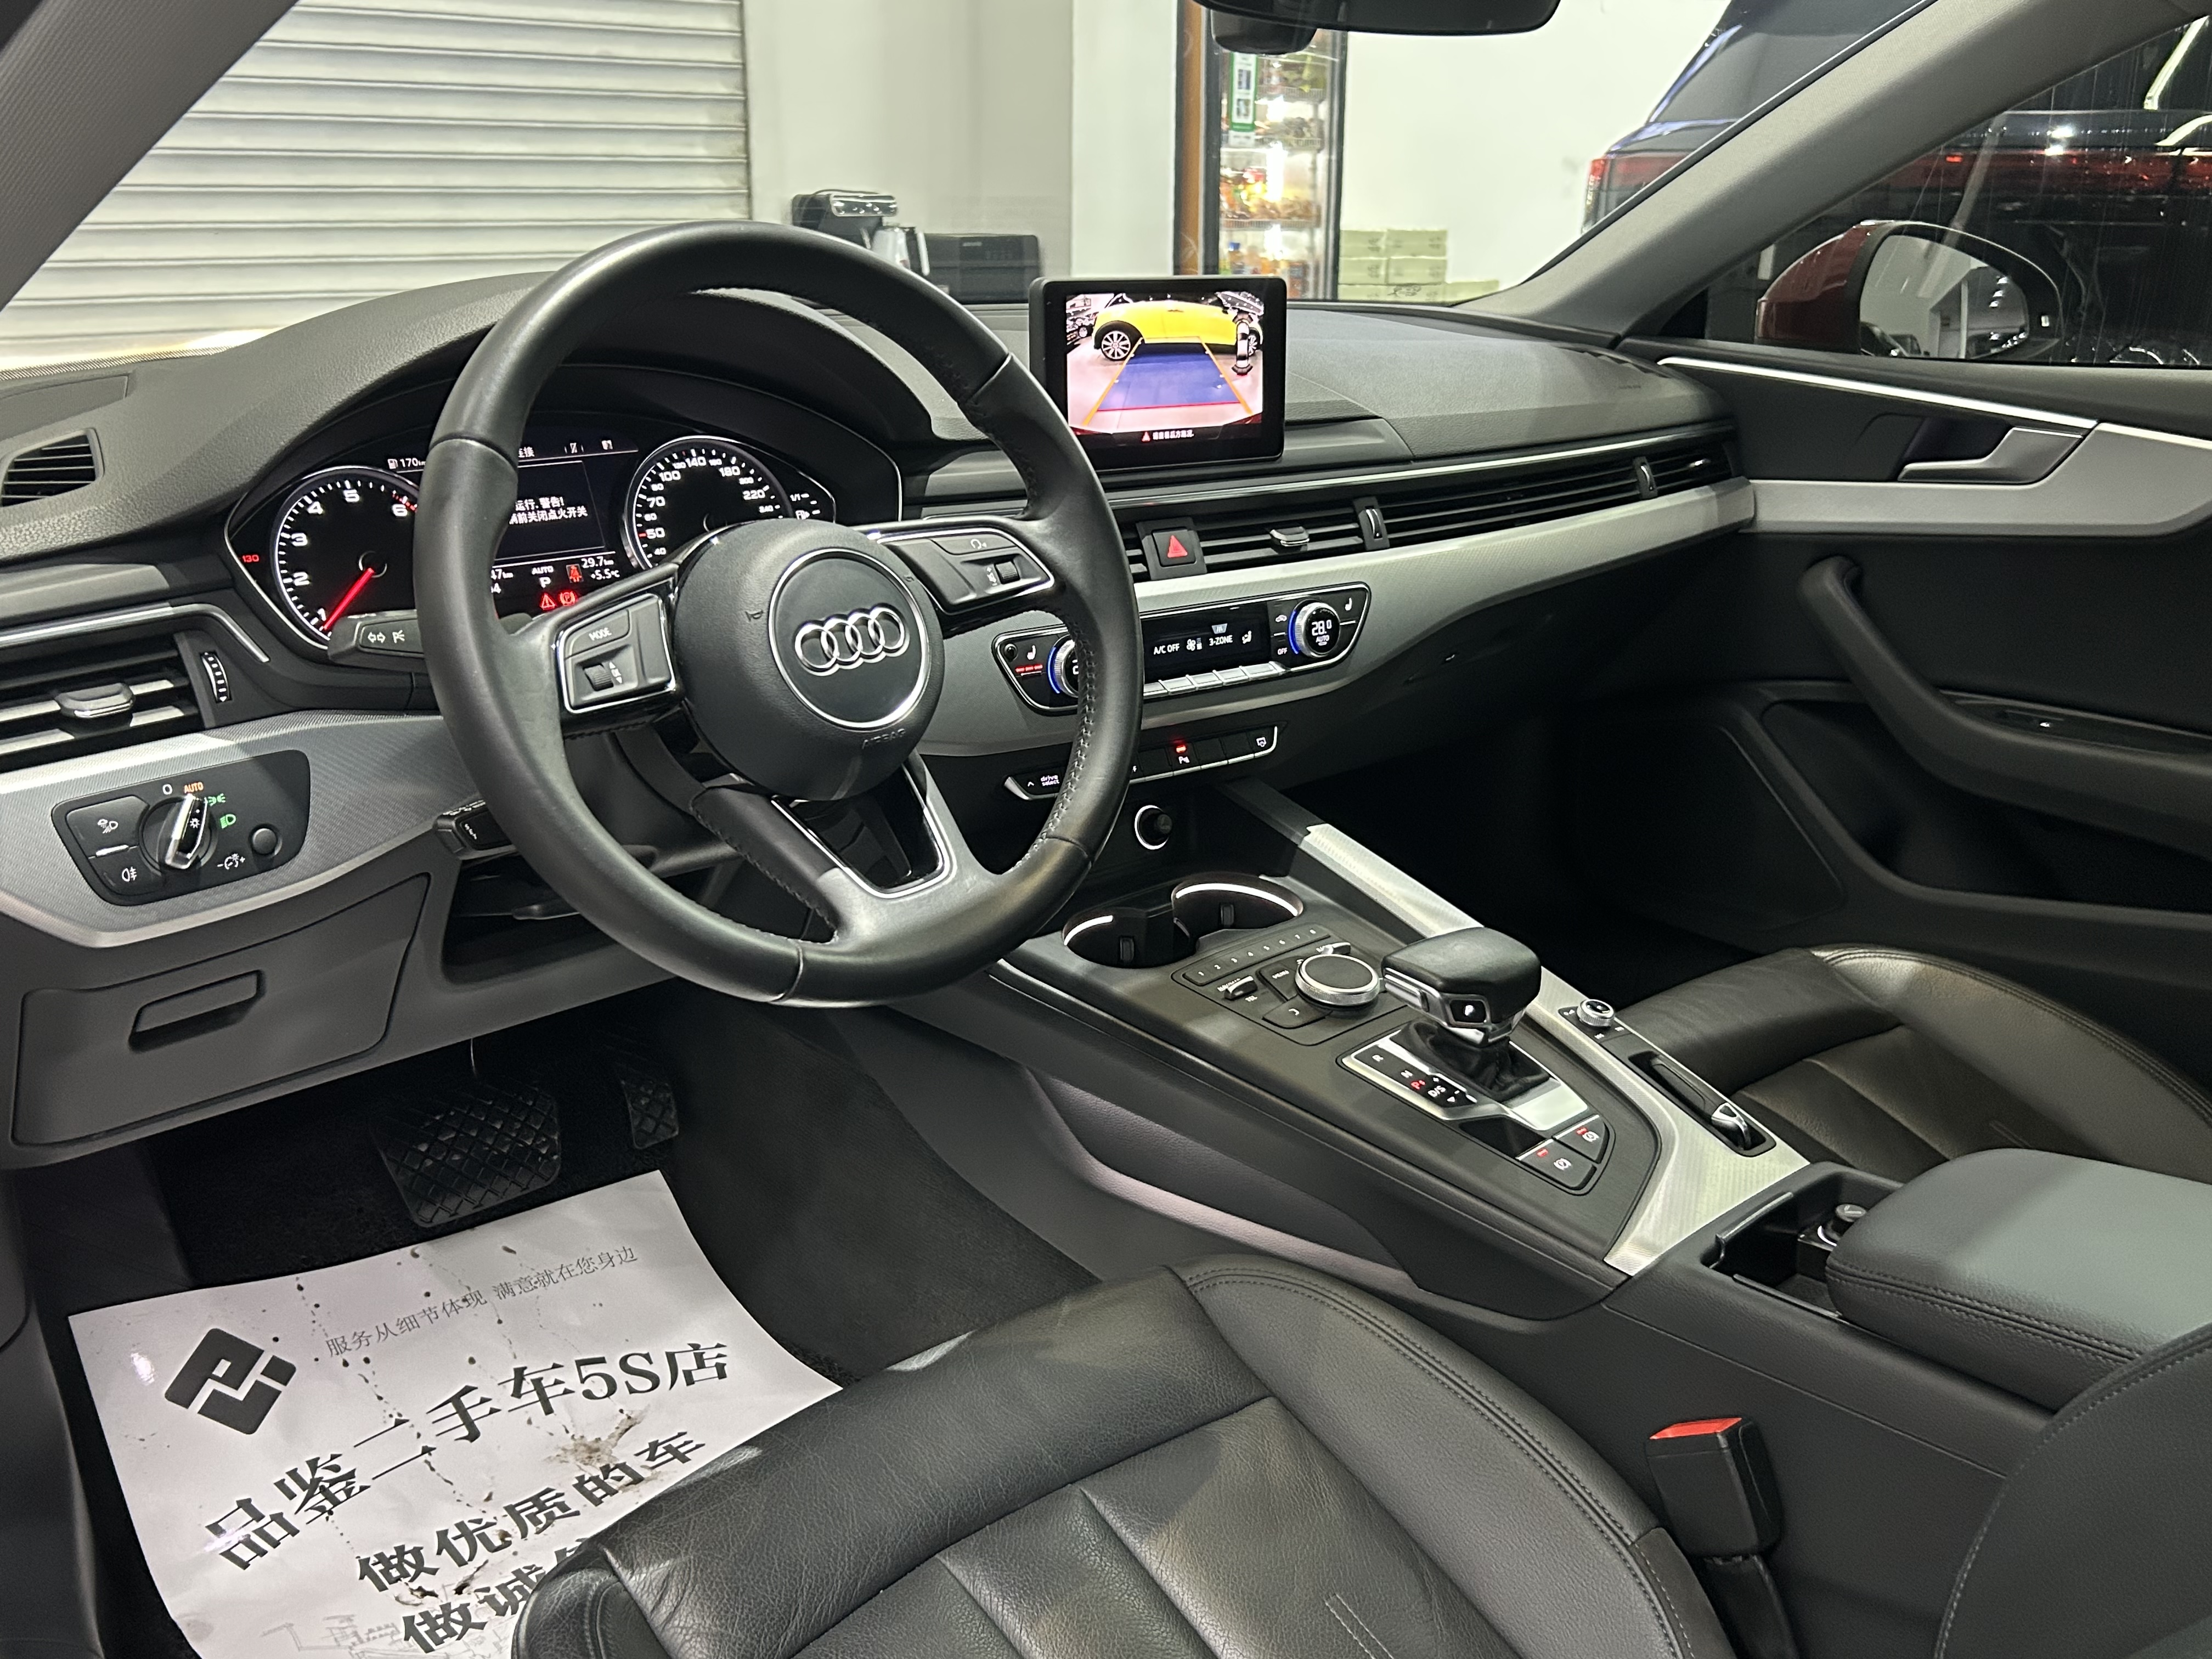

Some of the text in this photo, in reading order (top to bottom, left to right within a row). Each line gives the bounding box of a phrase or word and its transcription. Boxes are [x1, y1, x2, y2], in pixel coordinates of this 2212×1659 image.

[686, 456, 707, 467] 140
[659, 471, 681, 482] 100
[719, 466, 741, 477] 180
[343, 489, 360, 502] 5
[743, 489, 765, 500] 220
[647, 496, 665, 507] 70
[307, 501, 323, 514] 4
[392, 504, 408, 516] 6
[644, 513, 657, 521] 60
[646, 527, 665, 539] 50
[291, 533, 308, 546] 3
[242, 554, 259, 562] 130
[532, 566, 554, 574] AUTO
[293, 572, 310, 586] 2
[539, 577, 551, 588] P
[317, 608, 326, 621] 1
[1312, 619, 1332, 636] 28.0
[589, 628, 612, 640] MODE
[1209, 635, 1233, 646] 3-ZONE
[1153, 643, 1180, 654] A/C OFF
[184, 782, 204, 793] AUTO
[1464, 1005, 1475, 1016] P
[1401, 1070, 1413, 1079] N
[1427, 1085, 1446, 1098] D/S
[326, 1245, 639, 1357] 服务从细节体现 满意就在您身边
[205, 1342, 728, 1570] 品鉴二手车5S店
[358, 1431, 706, 1593] 做优质的车
[402, 1537, 588, 1654] 做诚
